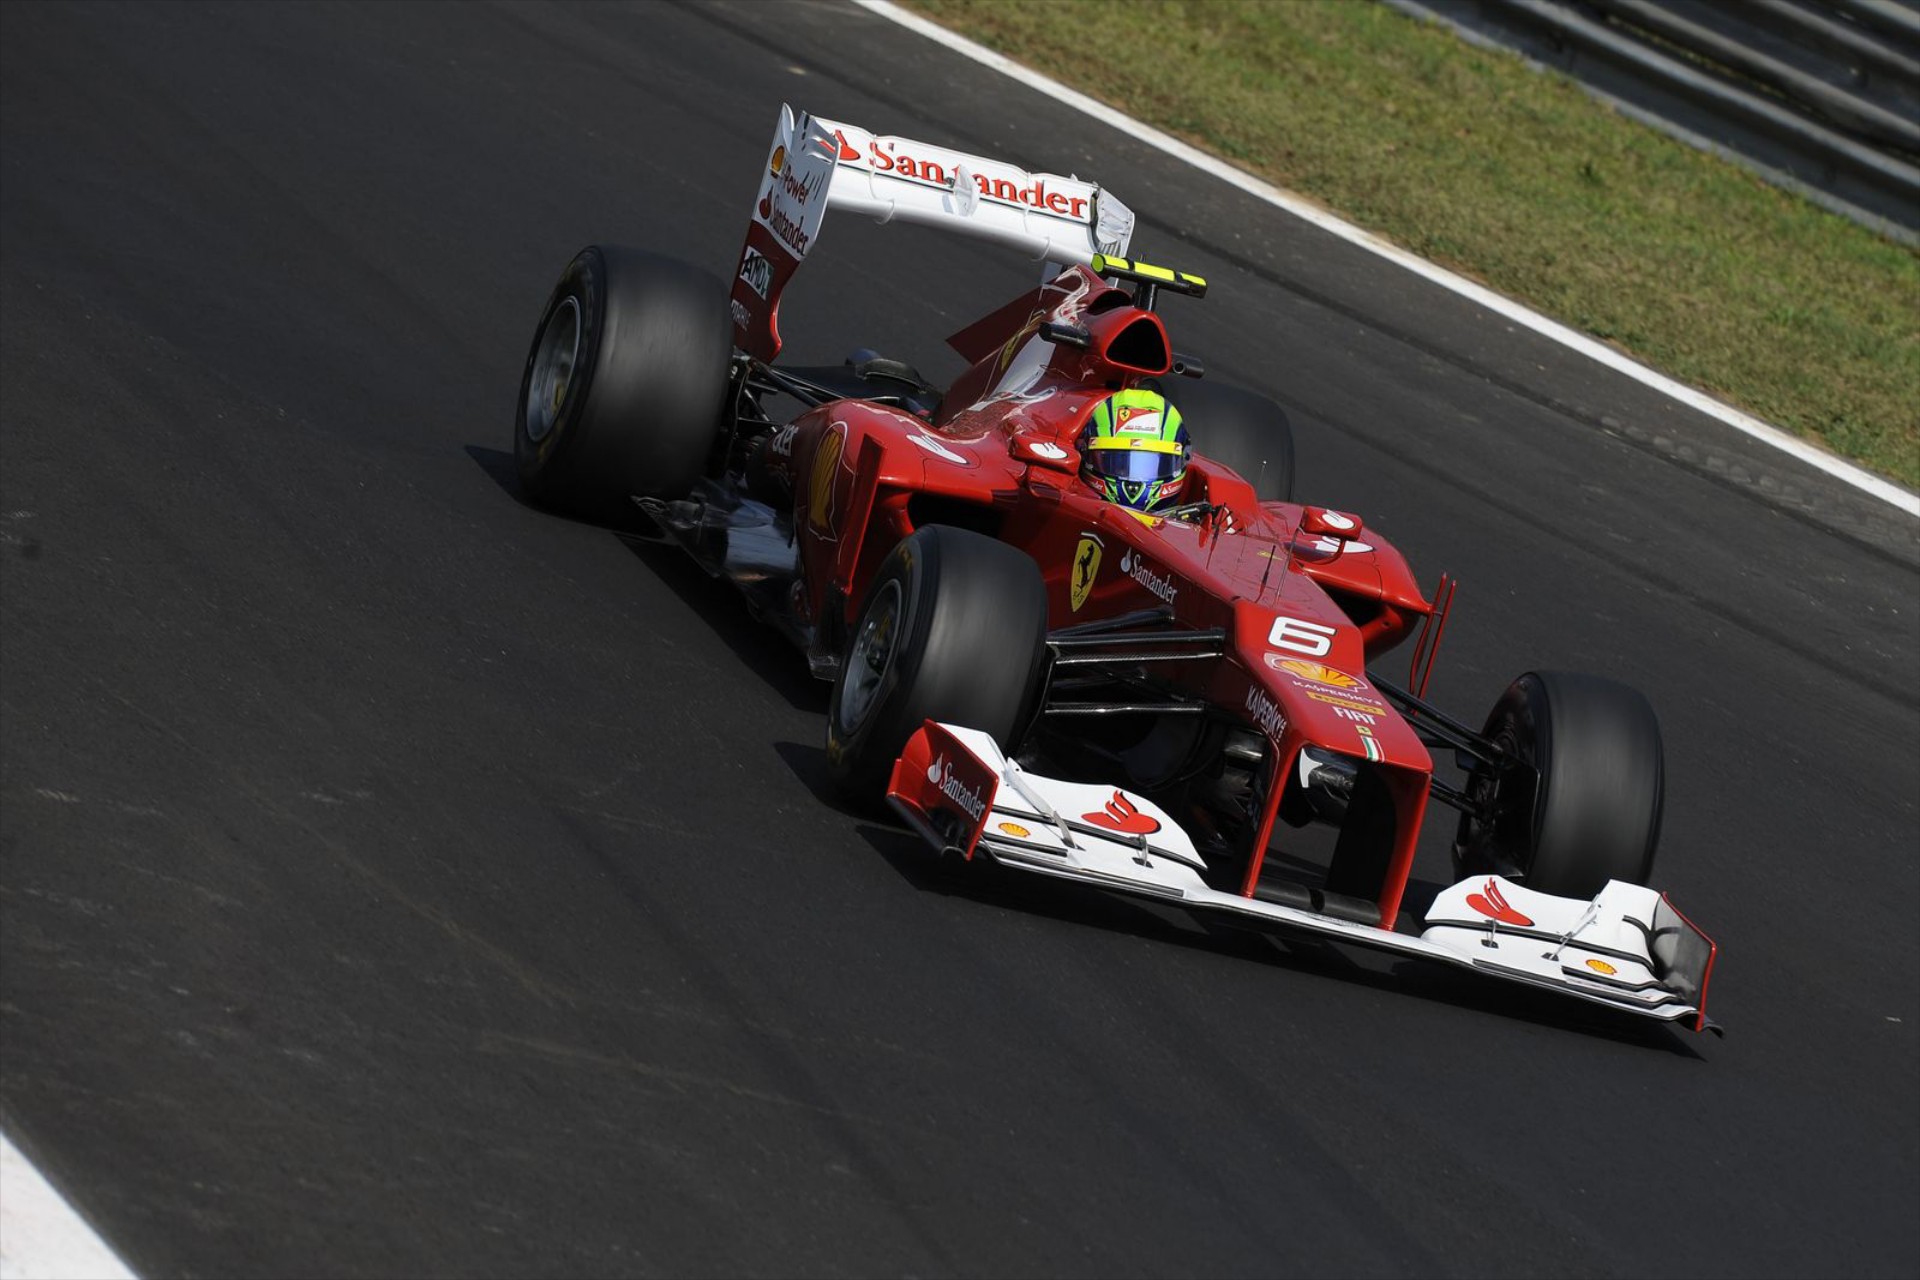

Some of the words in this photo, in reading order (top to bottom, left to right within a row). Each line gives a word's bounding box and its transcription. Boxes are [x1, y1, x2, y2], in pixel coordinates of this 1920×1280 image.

[869, 142, 1088, 218] Sanander
[769, 193, 810, 257] Santander
[1130, 553, 1178, 605] Santander
[1268, 616, 1338, 656] 6
[1332, 706, 1376, 725] FIAT
[939, 761, 987, 824] Santander
